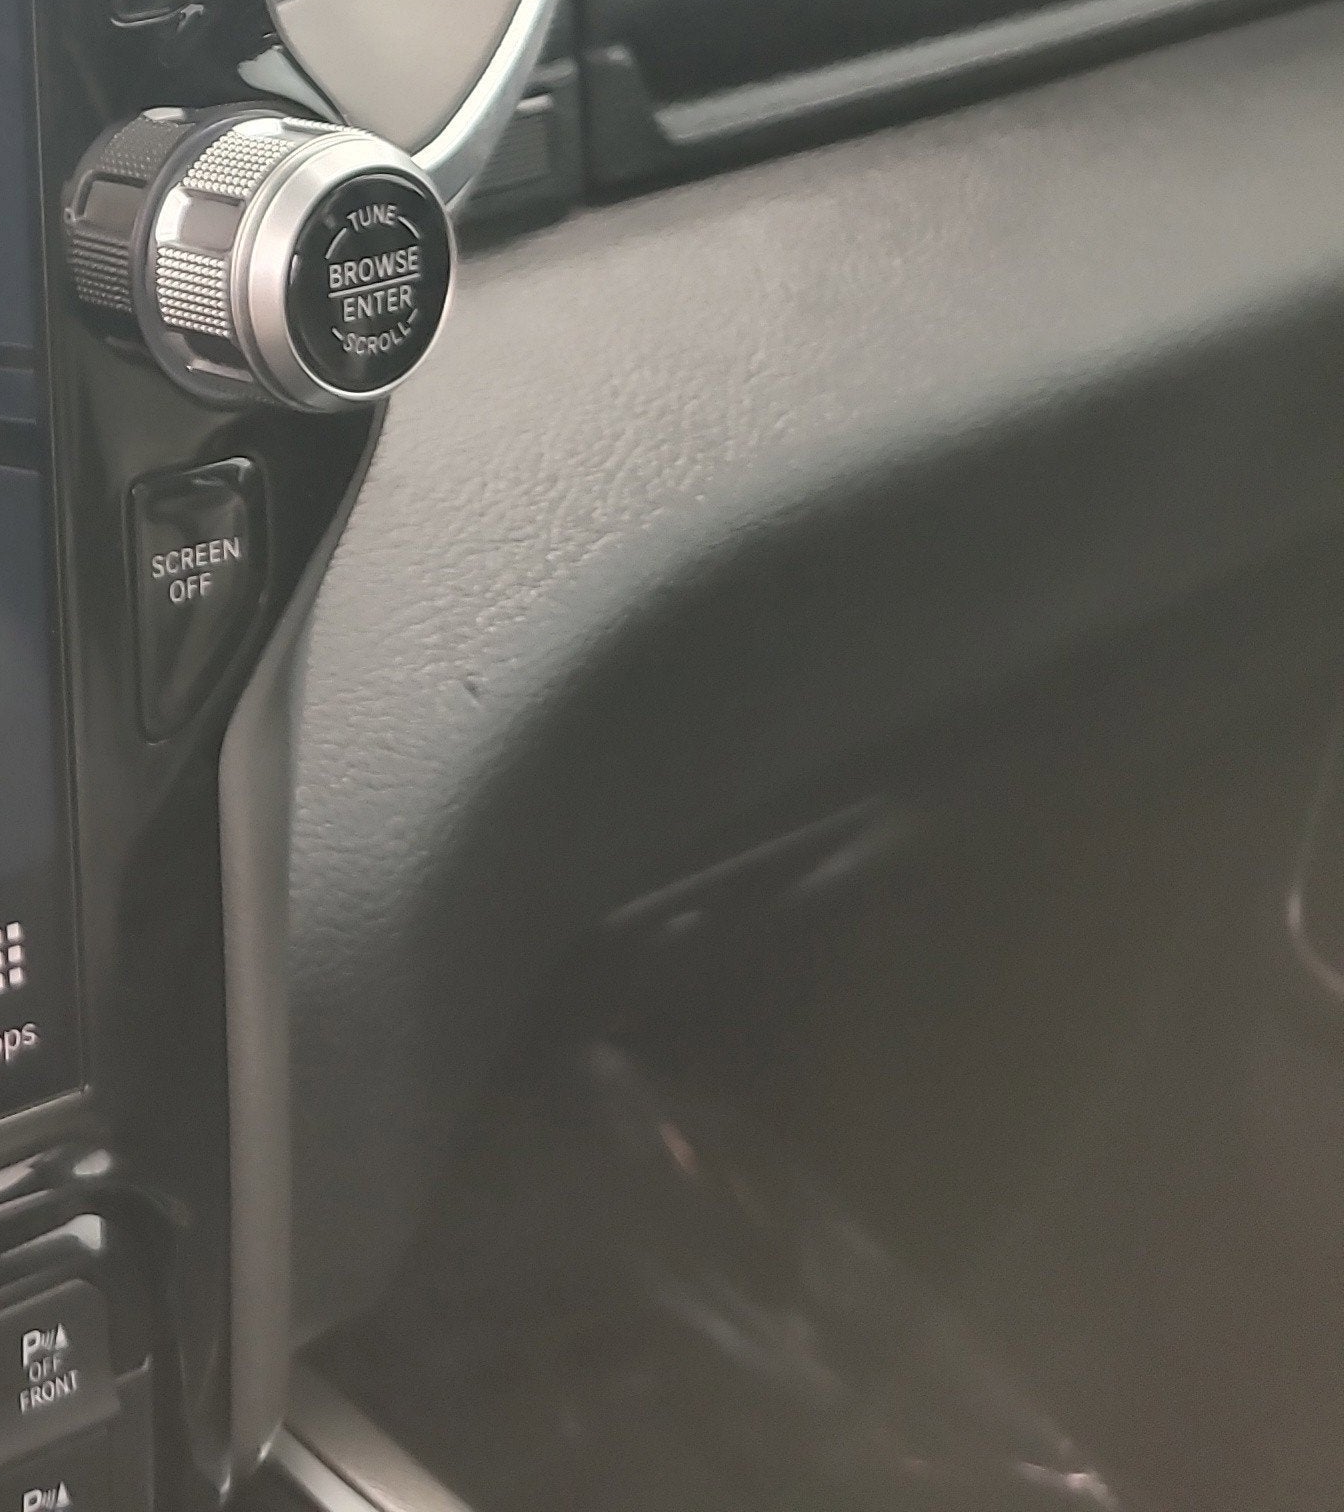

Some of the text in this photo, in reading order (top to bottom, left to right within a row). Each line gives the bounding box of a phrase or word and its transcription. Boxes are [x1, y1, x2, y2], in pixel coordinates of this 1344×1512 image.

[348, 205, 397, 231] TUNE
[329, 245, 420, 288] BROWSE
[344, 286, 412, 322] ENTER
[342, 320, 411, 355] SCROLL
[152, 538, 240, 578] SCREEN
[169, 572, 212, 604] OFF
[28, 1353, 62, 1382] OFF
[20, 1369, 78, 1414] FRONT
